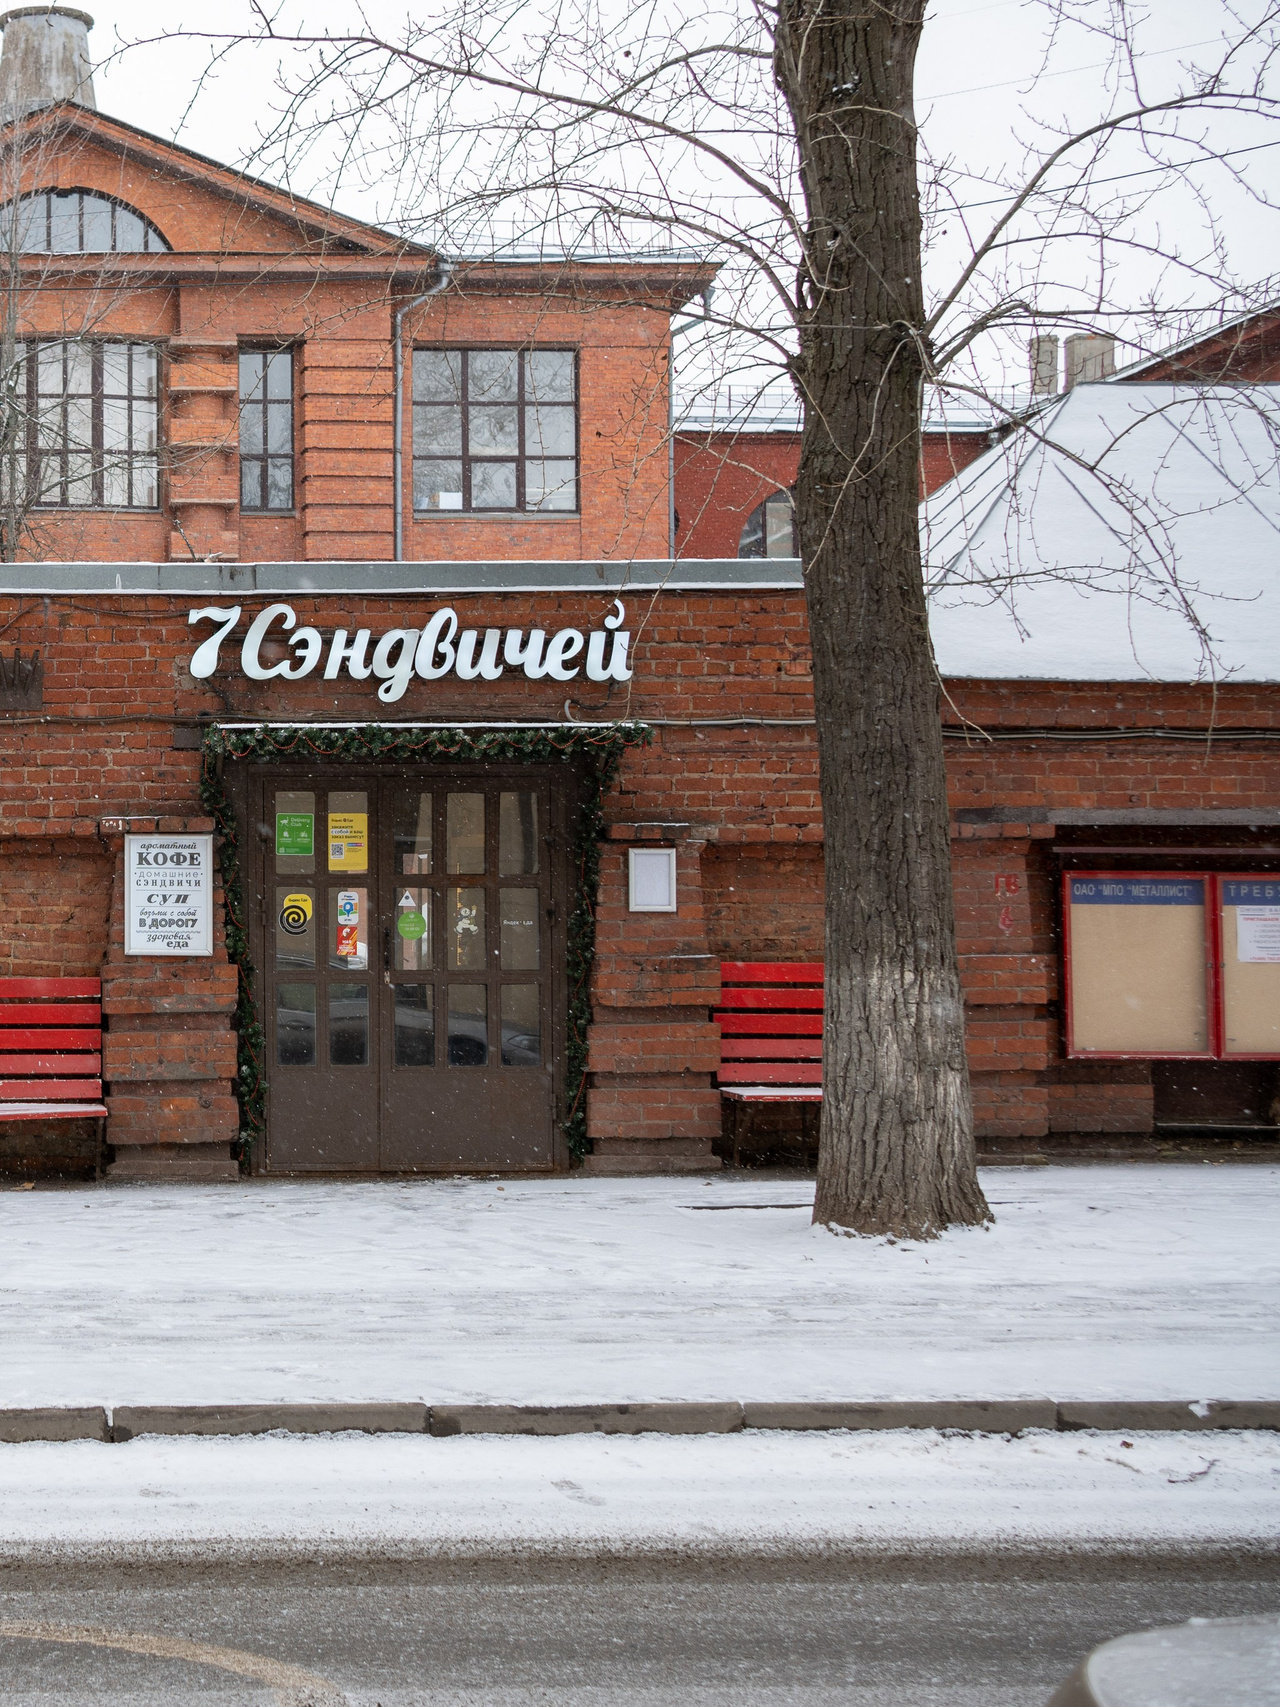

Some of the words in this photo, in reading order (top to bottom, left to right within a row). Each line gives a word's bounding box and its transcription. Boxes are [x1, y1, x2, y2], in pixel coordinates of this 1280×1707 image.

[188, 605, 242, 679] 7
[240, 598, 634, 703] Сэндвичей
[140, 841, 197, 851] ароматный
[136, 852, 201, 866] КОФЕ
[138, 871, 199, 879] домашние
[136, 879, 201, 888] СЭНДВИЧИ
[1073, 884, 1095, 895] ОАО
[1228, 885, 1280, 897] ТРЕБ
[139, 908, 167, 918] возьми
[177, 908, 197, 916] собой
[139, 918, 147, 927] В
[149, 918, 198, 929] ДОРОГУ
[147, 932, 192, 942] здоровая
[166, 941, 189, 949] еда
